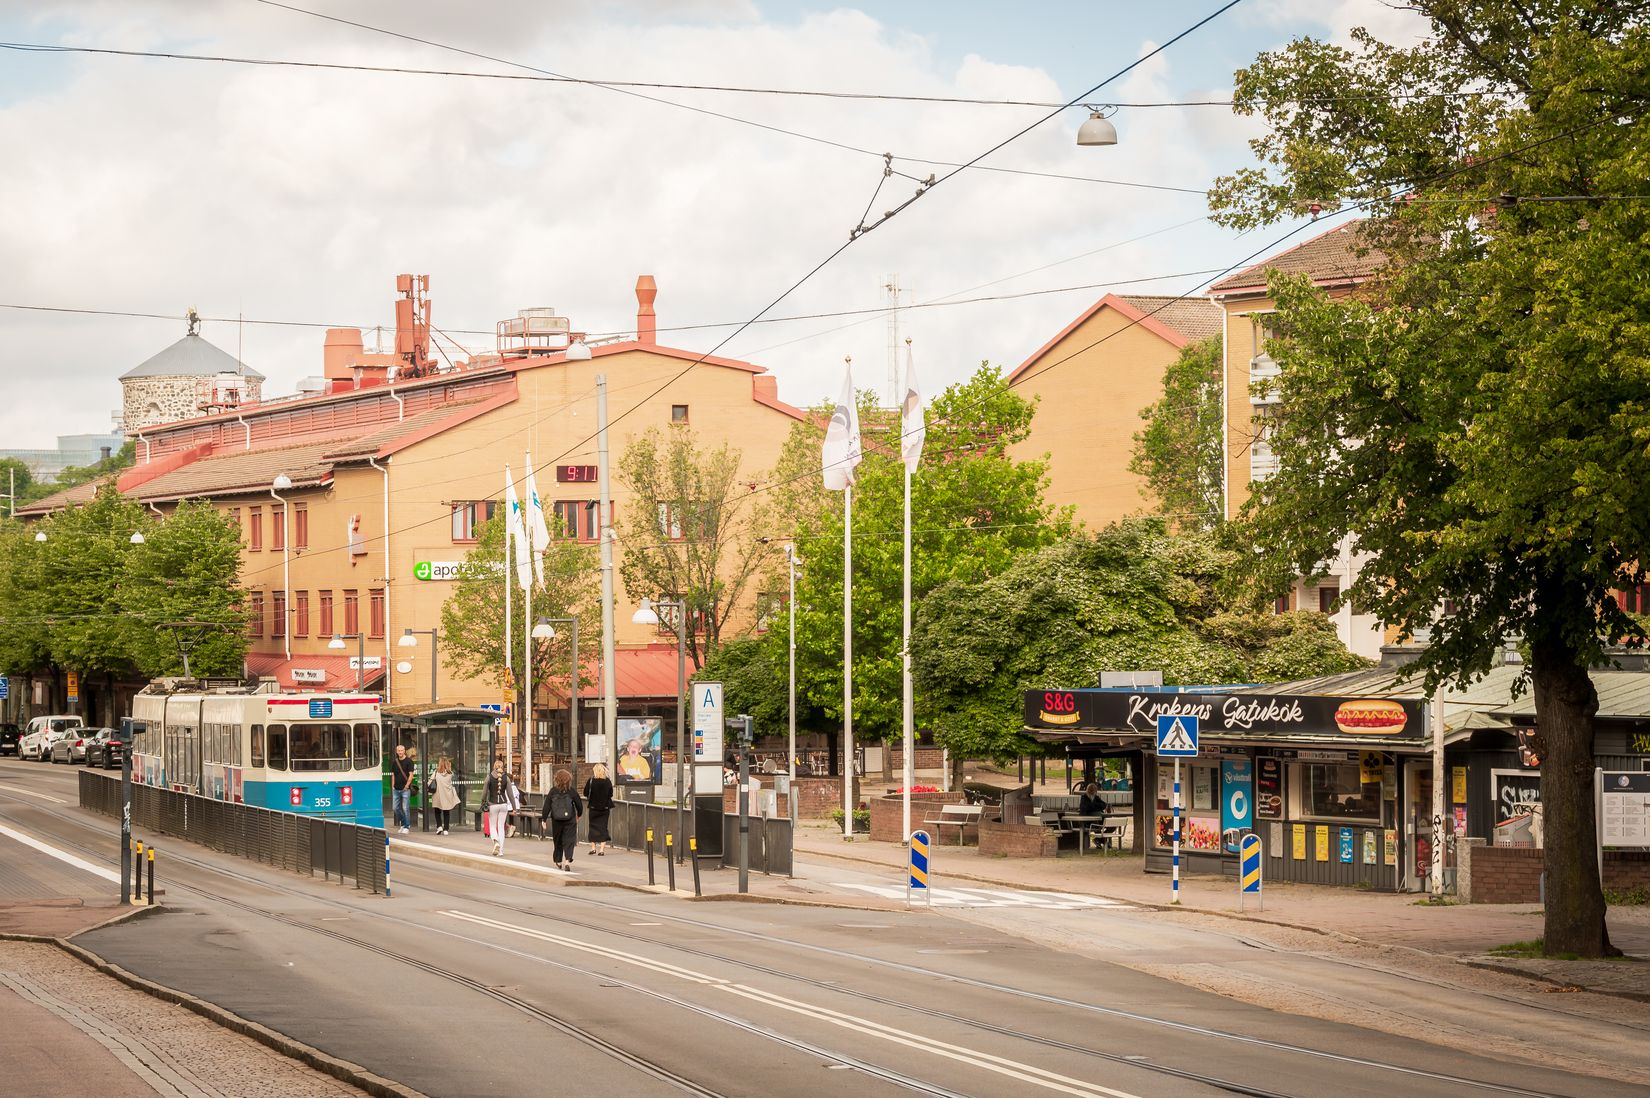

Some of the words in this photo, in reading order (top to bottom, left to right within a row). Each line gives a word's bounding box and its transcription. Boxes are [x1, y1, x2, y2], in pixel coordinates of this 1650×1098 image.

[567, 466, 597, 482] 9:11
[703, 688, 715, 708] A
[1045, 692, 1075, 712] S&G
[1126, 695, 1213, 728] Krokens
[1222, 697, 1304, 729] Gatukök
[314, 797, 331, 807] 355
